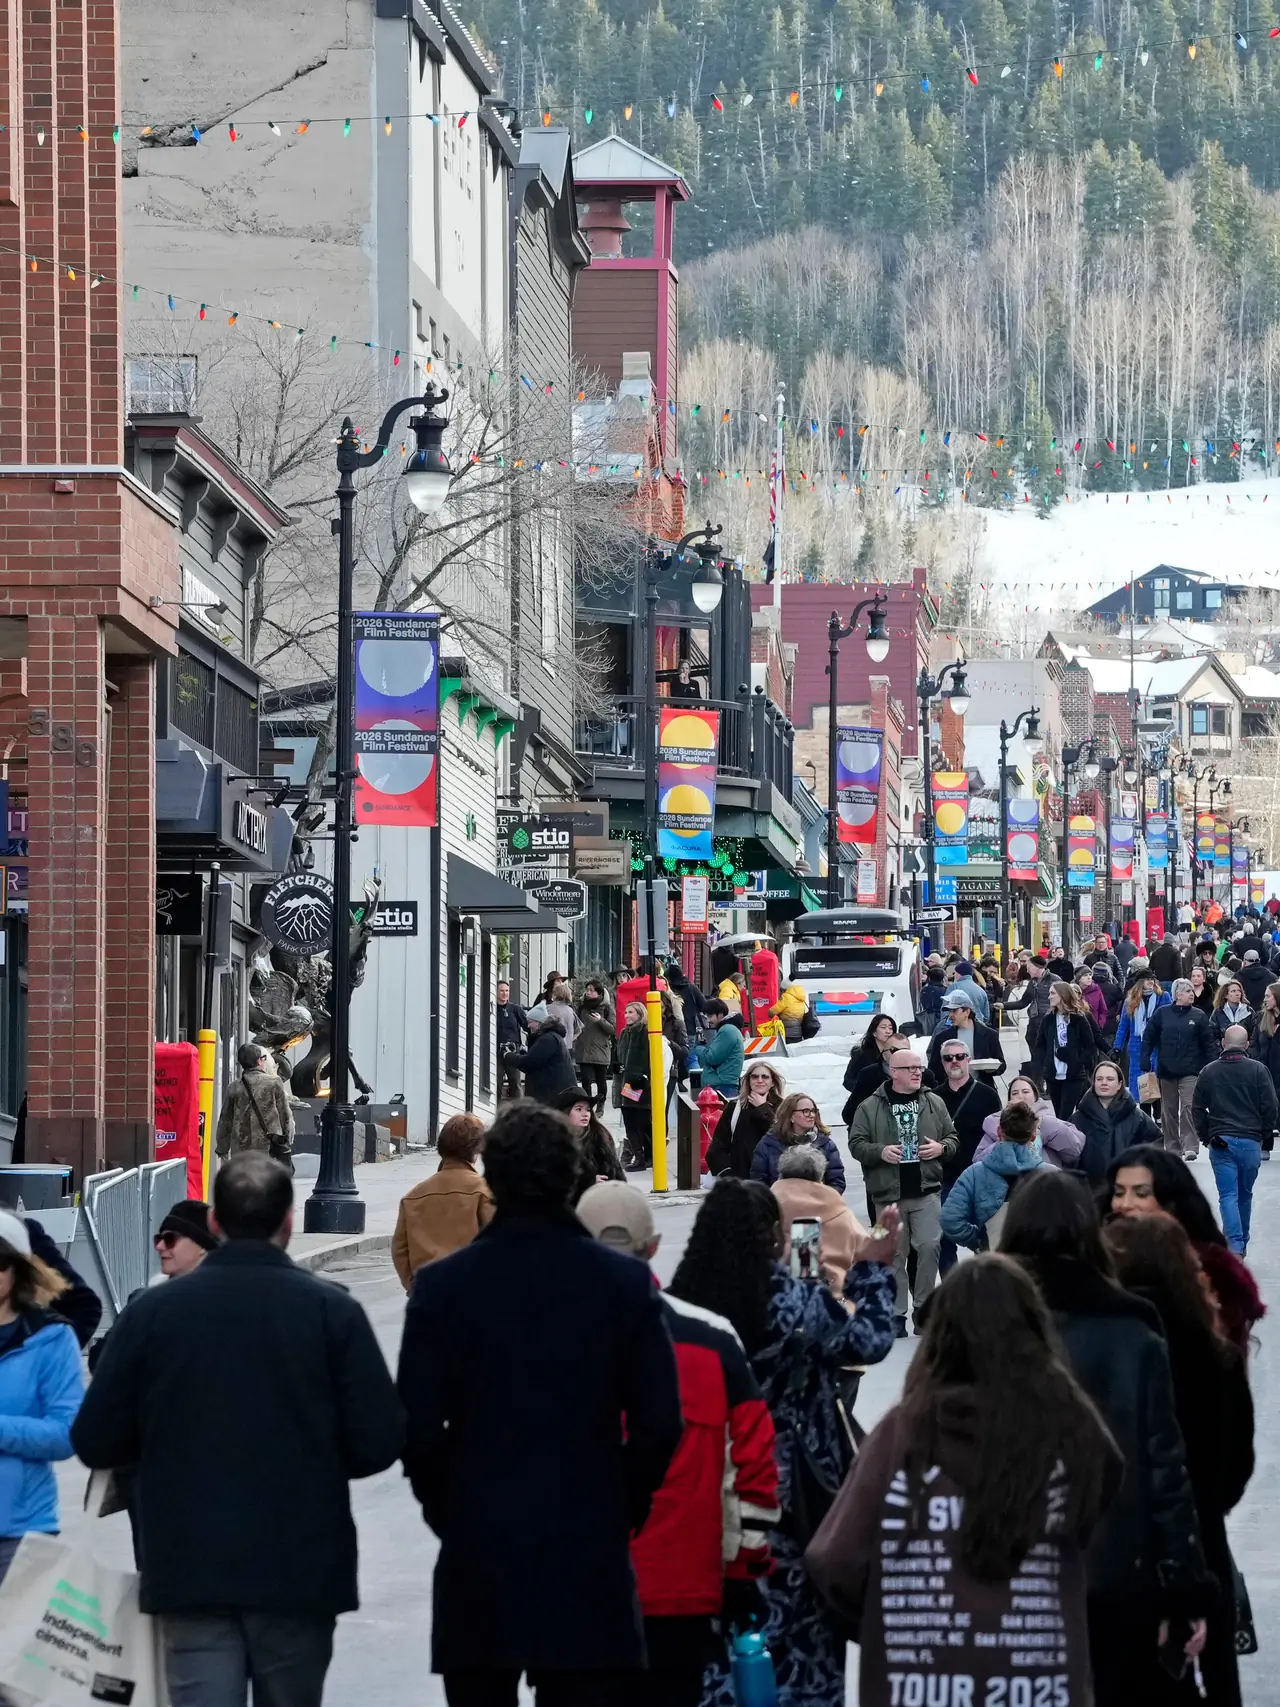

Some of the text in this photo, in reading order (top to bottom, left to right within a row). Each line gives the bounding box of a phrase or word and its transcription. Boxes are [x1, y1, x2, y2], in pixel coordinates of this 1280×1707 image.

[355, 618, 437, 629] 2026 Sundance
[364, 627, 429, 638] Film Festival
[28, 707, 96, 767] 580
[354, 731, 437, 742] 2026 Sundance
[362, 741, 429, 751] Film Festival
[678, 748, 715, 757] Sundance
[681, 754, 710, 763] Festival
[677, 815, 712, 823] Sundance
[531, 828, 569, 845] stio
[511, 870, 549, 881] AMERICAN
[264, 874, 334, 907] FLETCHER
[957, 882, 1000, 890] NAGAN'S
[535, 889, 580, 898] Windermere
[373, 907, 413, 926] stio
[277, 938, 332, 953] PARK UT
[42, 1610, 123, 1658] independent
[887, 1673, 1069, 1707] TOUR 2025
